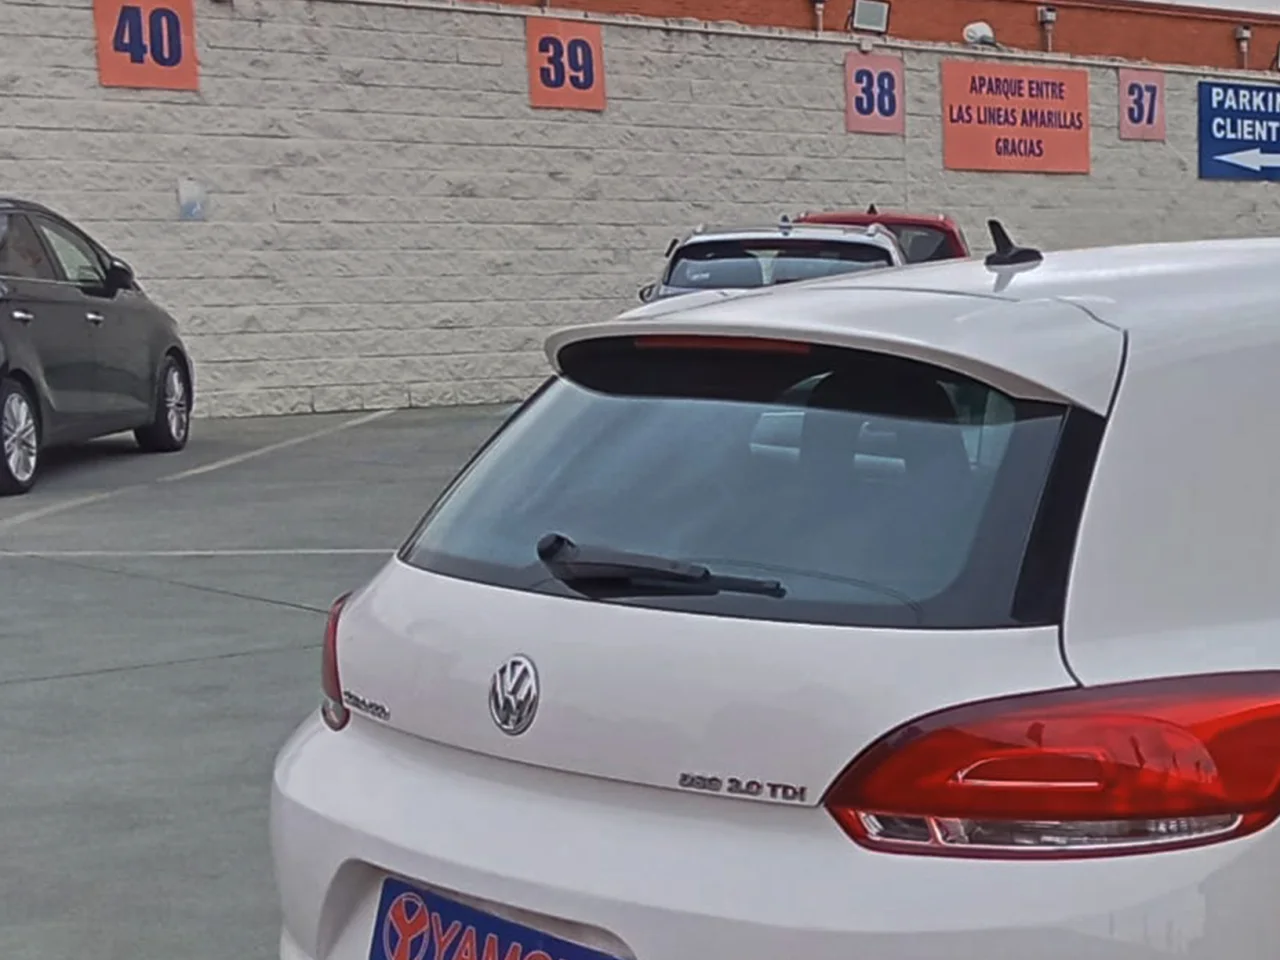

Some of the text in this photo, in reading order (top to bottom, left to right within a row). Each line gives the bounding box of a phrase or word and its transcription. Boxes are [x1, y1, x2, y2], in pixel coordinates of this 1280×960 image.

[112, 5, 182, 67] 40
[537, 36, 594, 89] 39
[854, 69, 897, 117] 38
[969, 75, 1065, 99] APARQUE ENTRE
[949, 106, 1083, 131] LAS LINEAS AMARILLAS
[1127, 83, 1158, 126] 37
[995, 138, 1044, 158] GRACIAS
[766, 782, 807, 802] TDI
